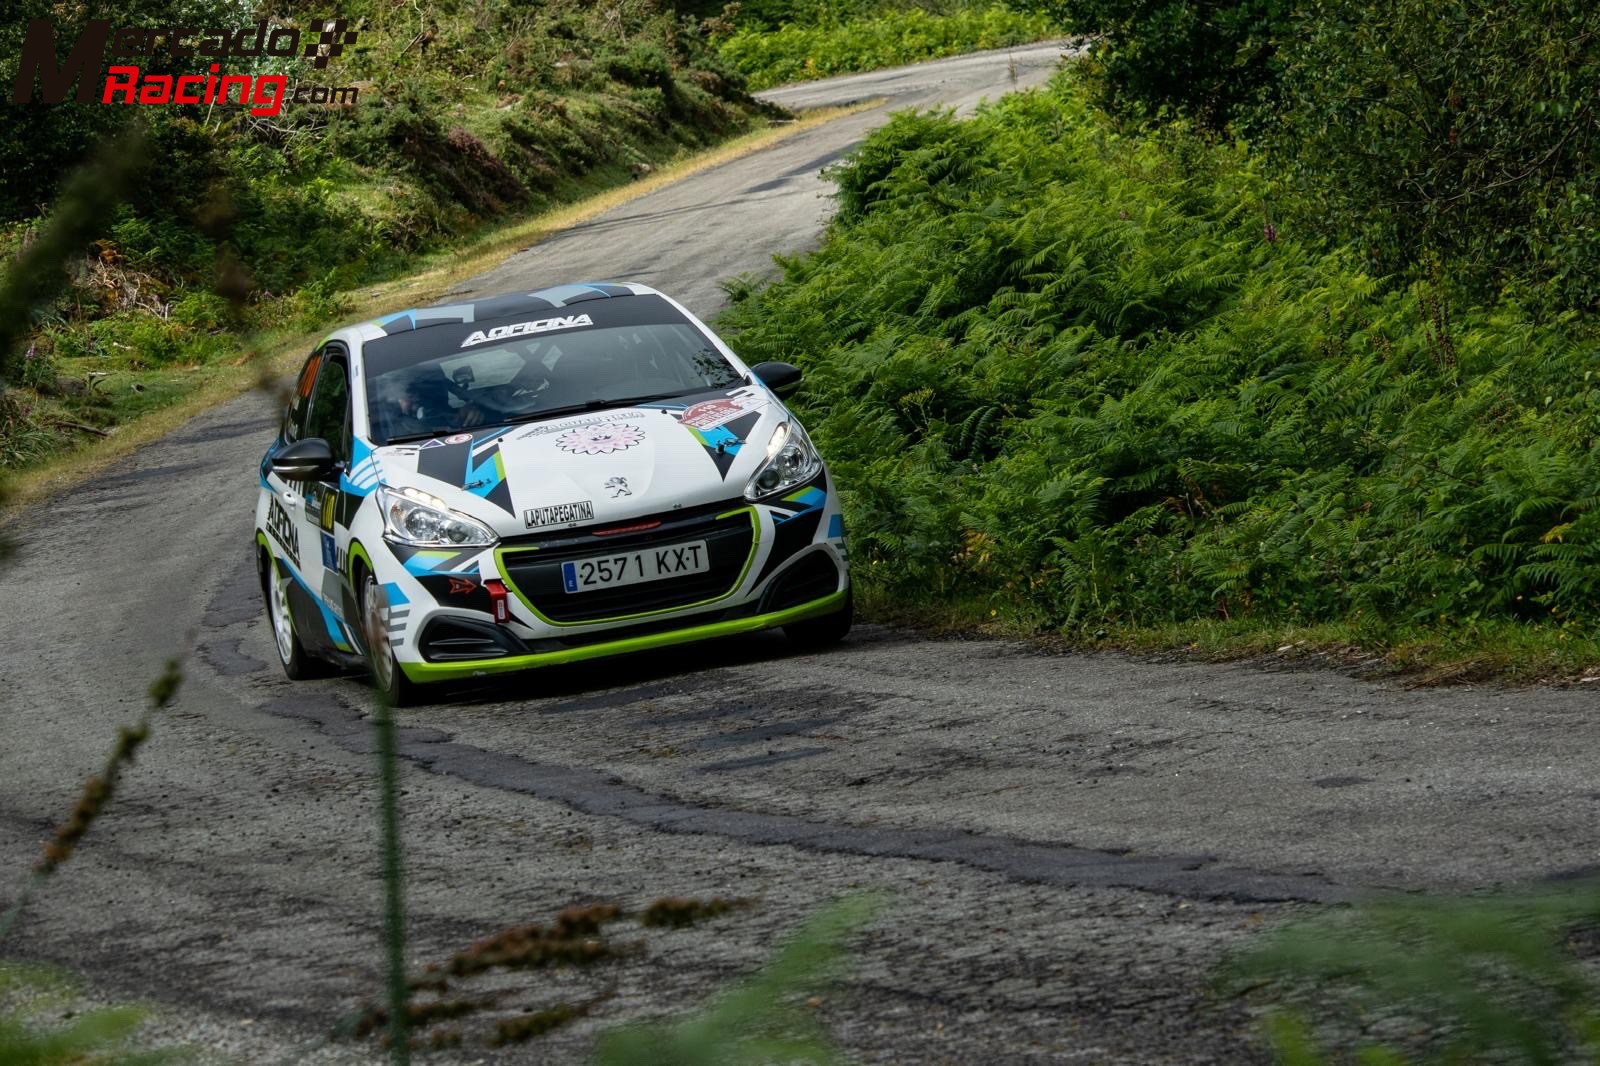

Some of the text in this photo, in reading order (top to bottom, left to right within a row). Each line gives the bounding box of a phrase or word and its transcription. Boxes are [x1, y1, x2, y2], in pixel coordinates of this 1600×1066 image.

[526, 503, 592, 527] LAPUTAPEGATINA
[582, 554, 644, 585] 2571
[655, 545, 701, 574] KXT
